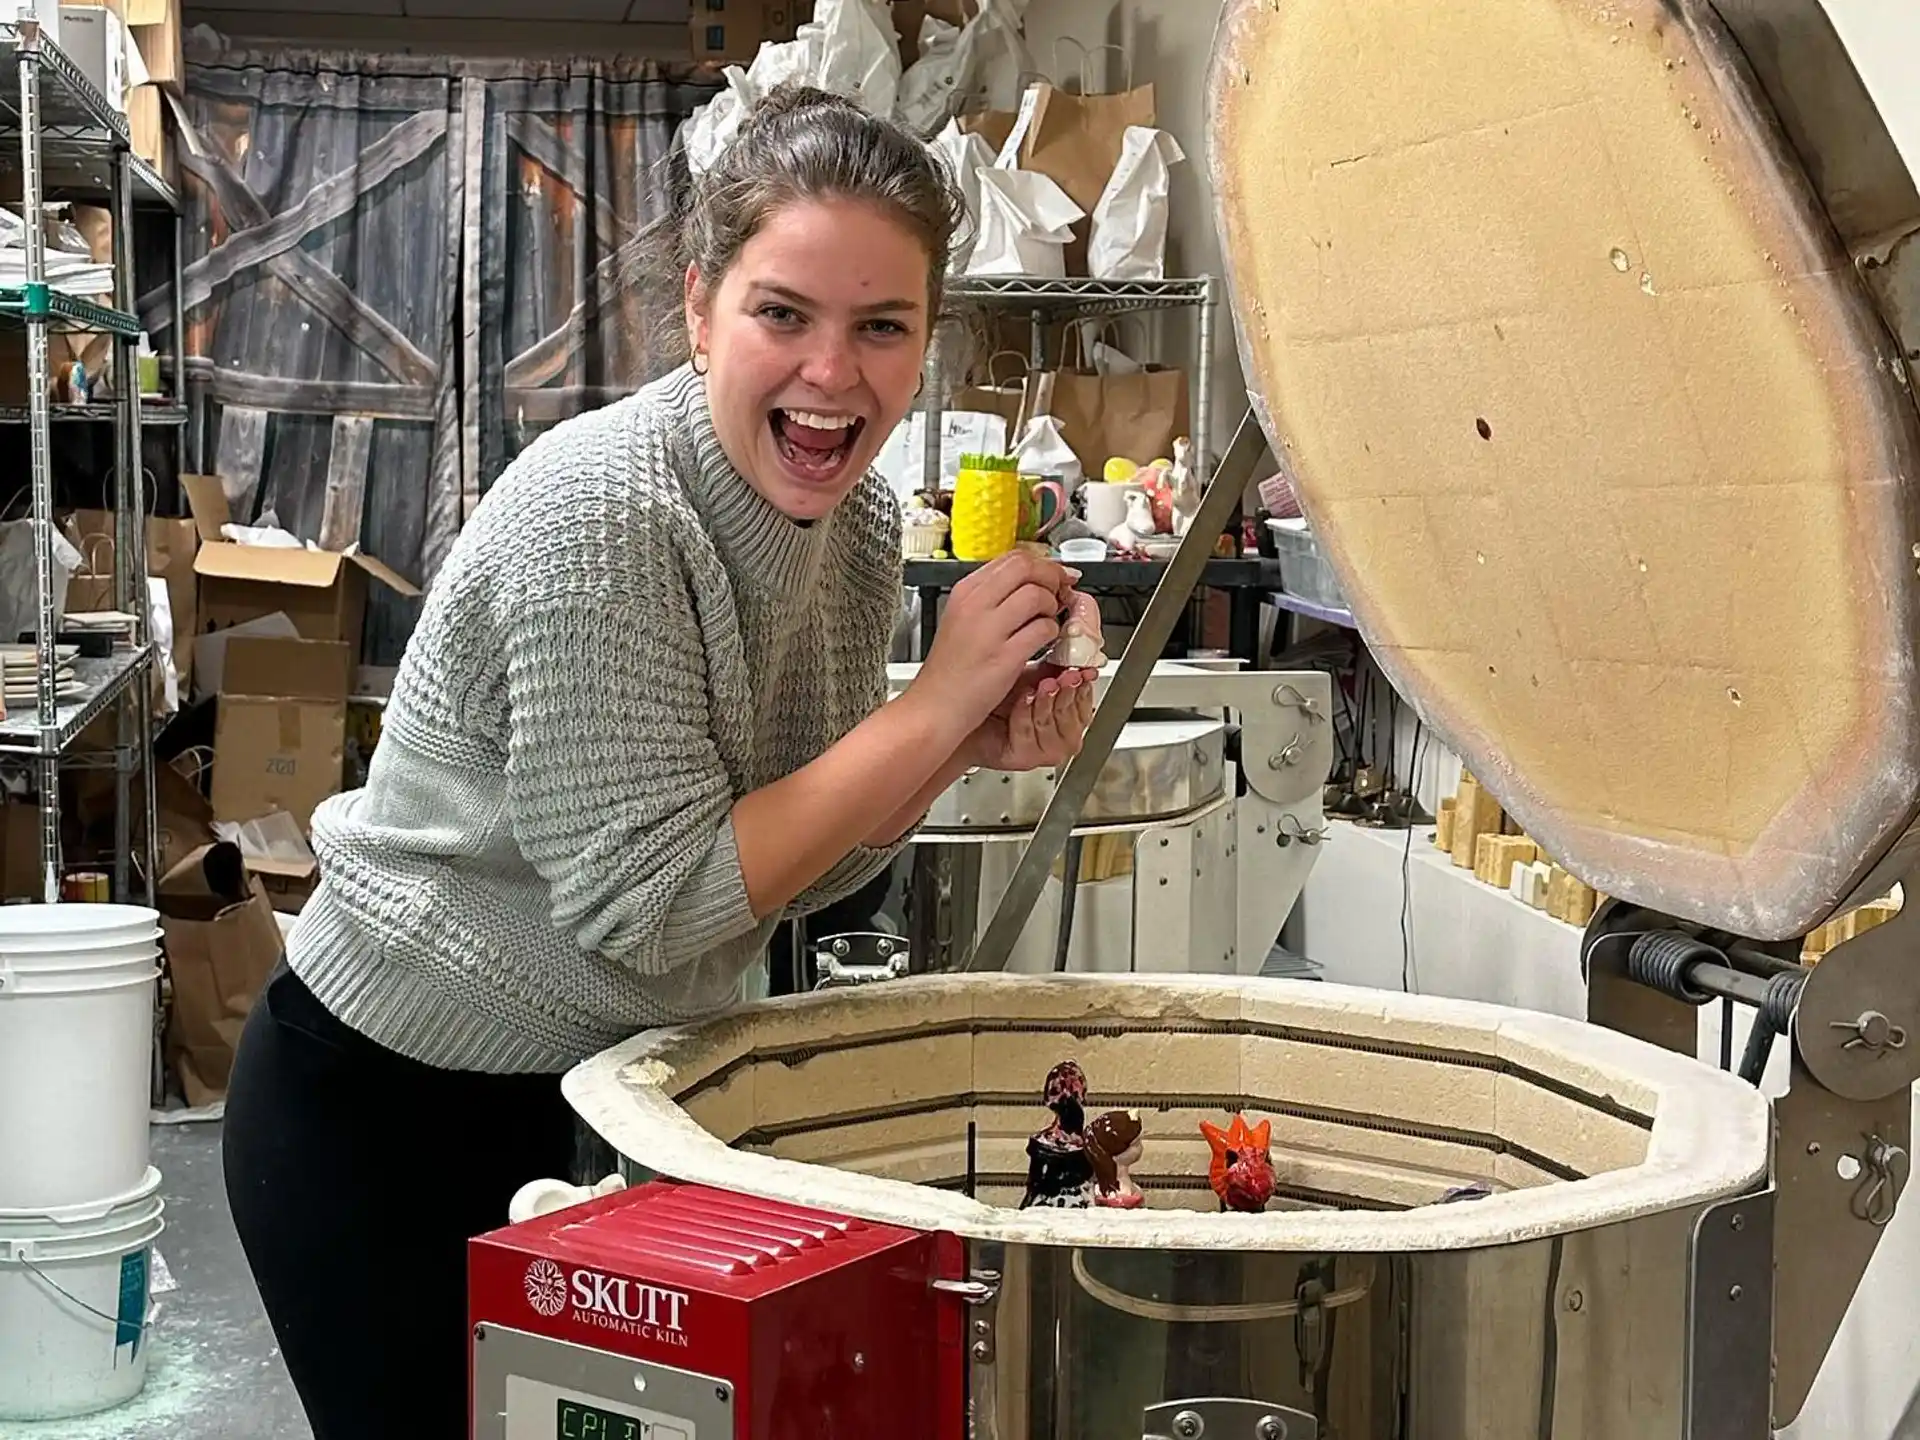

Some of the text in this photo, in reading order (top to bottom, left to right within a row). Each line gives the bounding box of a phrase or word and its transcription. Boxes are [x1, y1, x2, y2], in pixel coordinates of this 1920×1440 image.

[571, 1269, 689, 1331] SKUTT
[572, 1309, 688, 1347] AUTOMATIC KILN
